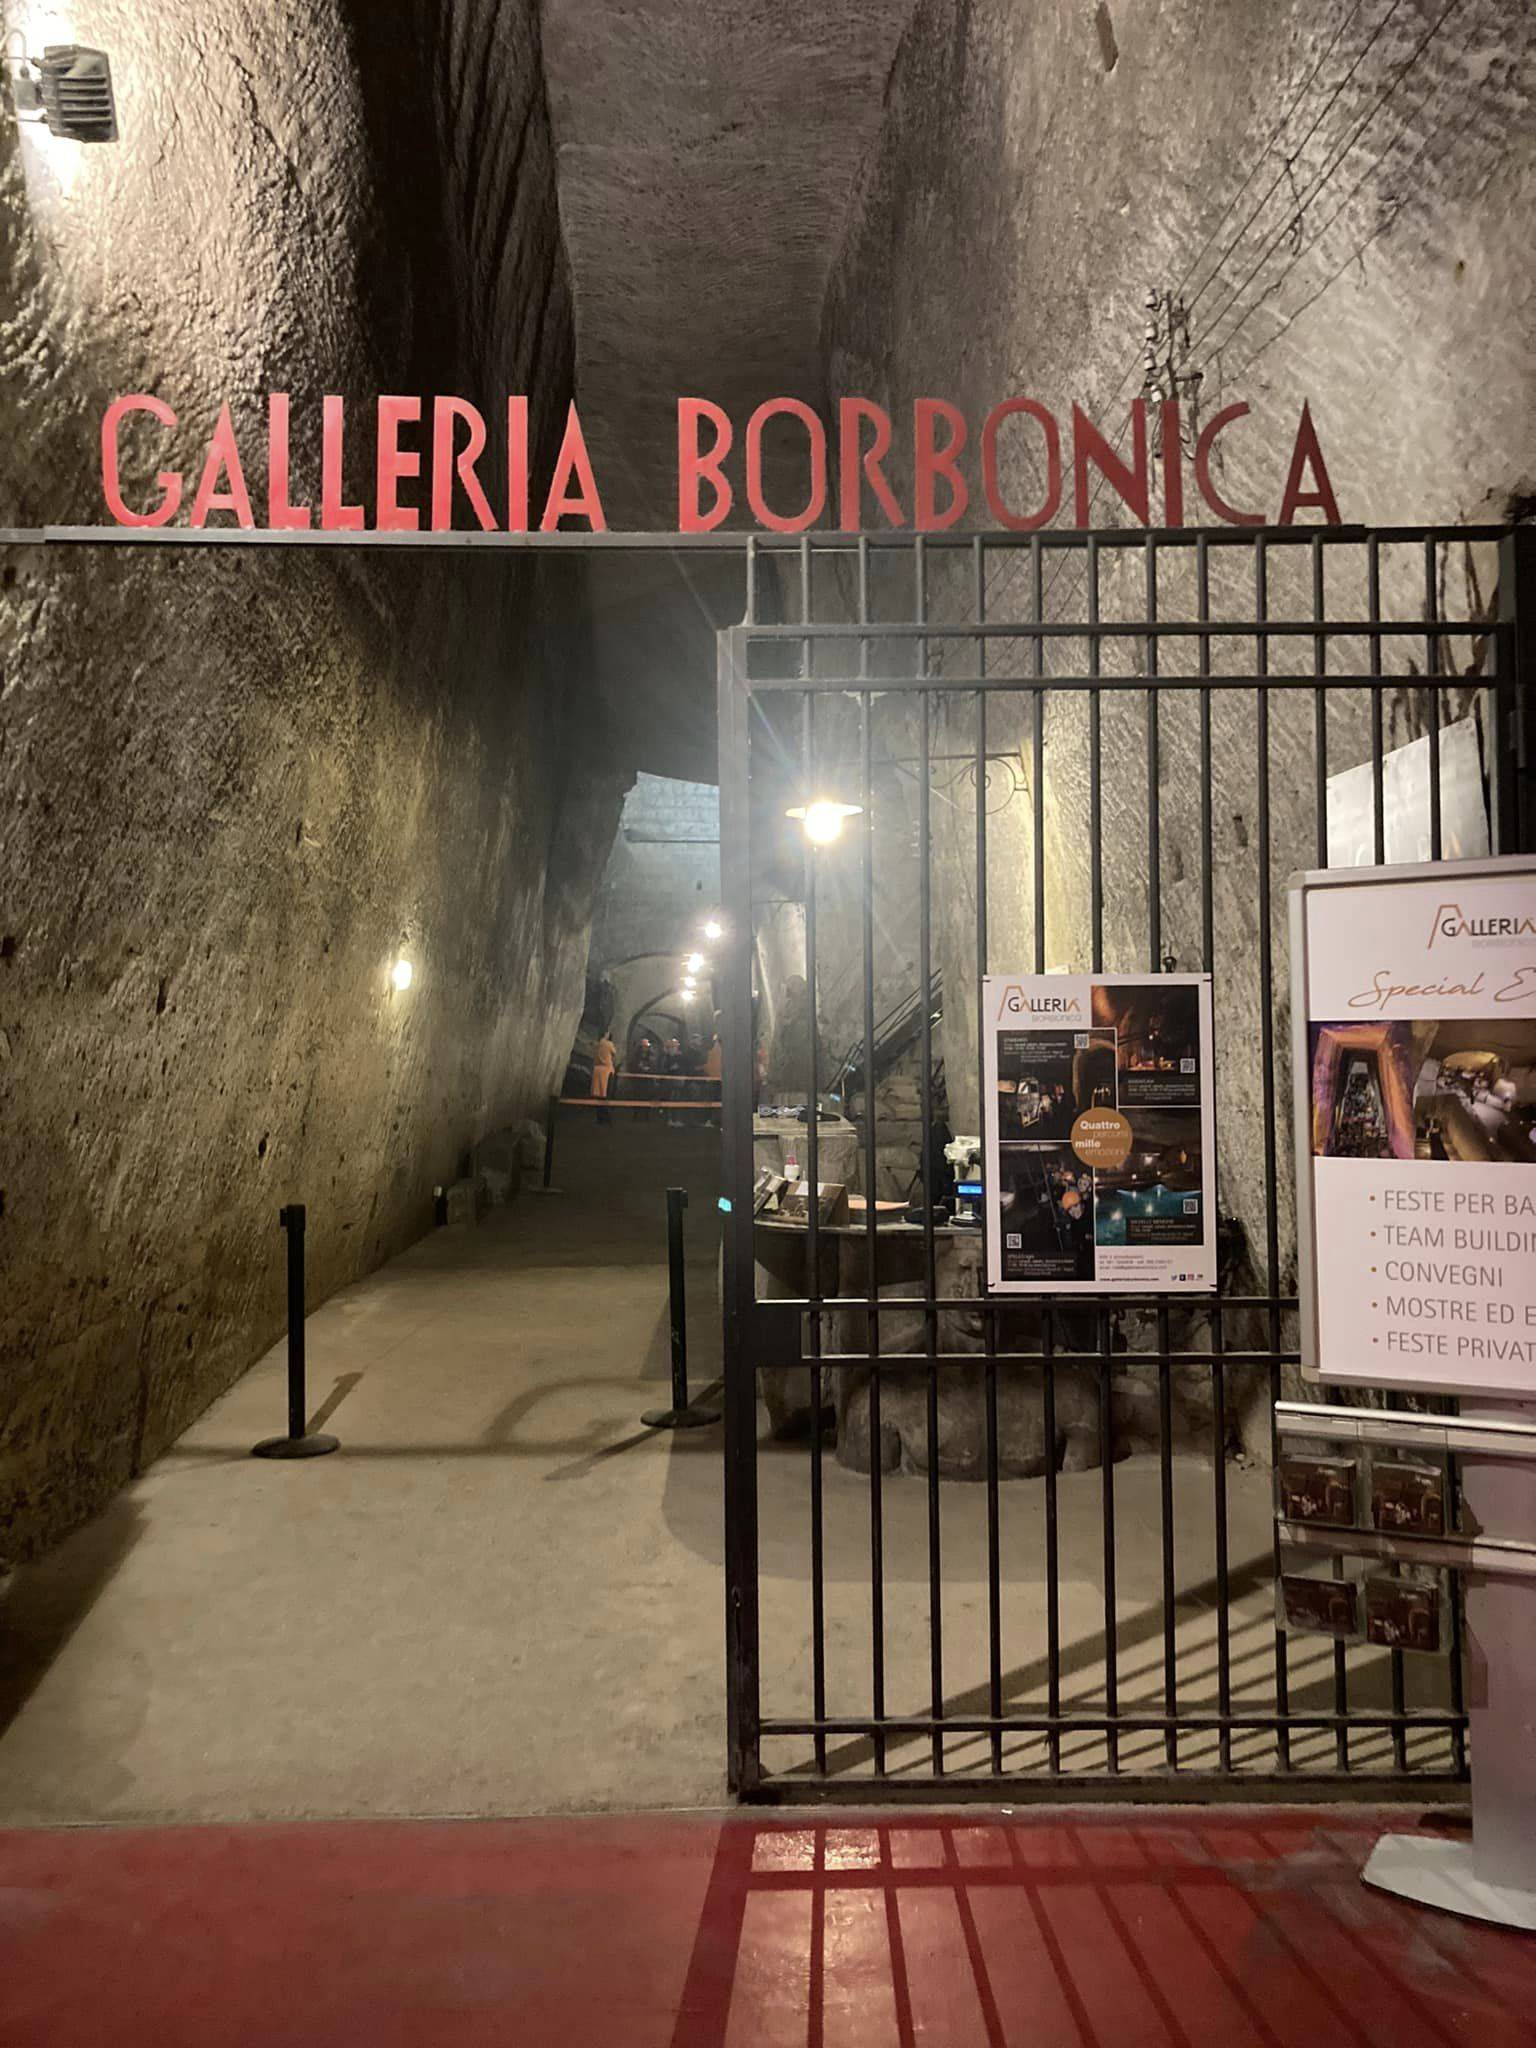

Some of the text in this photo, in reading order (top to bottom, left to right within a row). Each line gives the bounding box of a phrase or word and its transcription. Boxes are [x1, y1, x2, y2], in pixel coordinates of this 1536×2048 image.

[101, 393, 1343, 534] GALLERIA BORBONICA
[1347, 970, 1485, 1011] Special
[1007, 996, 1081, 1013] GALLERIA
[1080, 1120, 1121, 1130] Quattro
[1384, 1190, 1445, 1212] FESTE
[1454, 1193, 1495, 1215] PER
[1384, 1225, 1444, 1248] TEAM
[1385, 1261, 1503, 1288] CONVEGNI
[1386, 1296, 1477, 1322] MOSTRE
[1487, 1302, 1514, 1324] ED
[1387, 1331, 1449, 1355] FESTE
